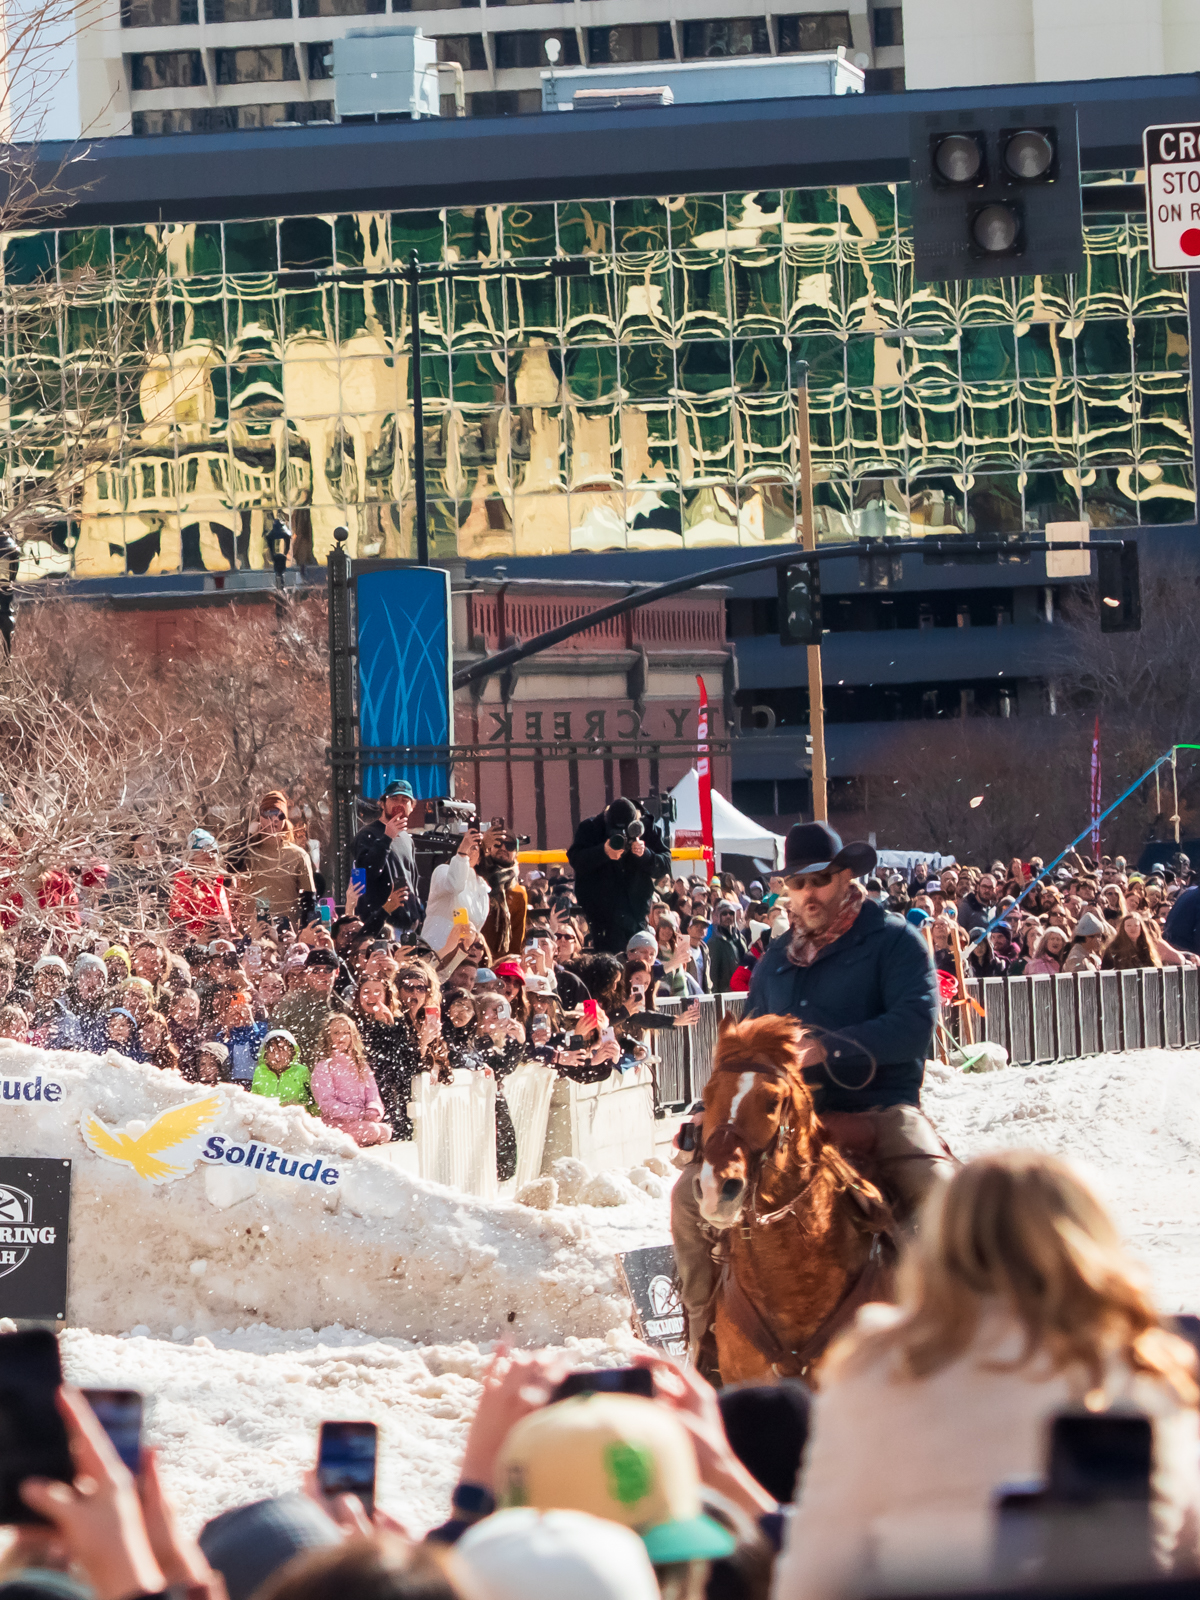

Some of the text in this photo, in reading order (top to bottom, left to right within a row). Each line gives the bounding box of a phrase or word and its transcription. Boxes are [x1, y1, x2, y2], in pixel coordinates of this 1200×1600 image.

[1159, 131, 1200, 161] CR
[1158, 203, 1182, 223] ON
[202, 1136, 339, 1186] Solitude
